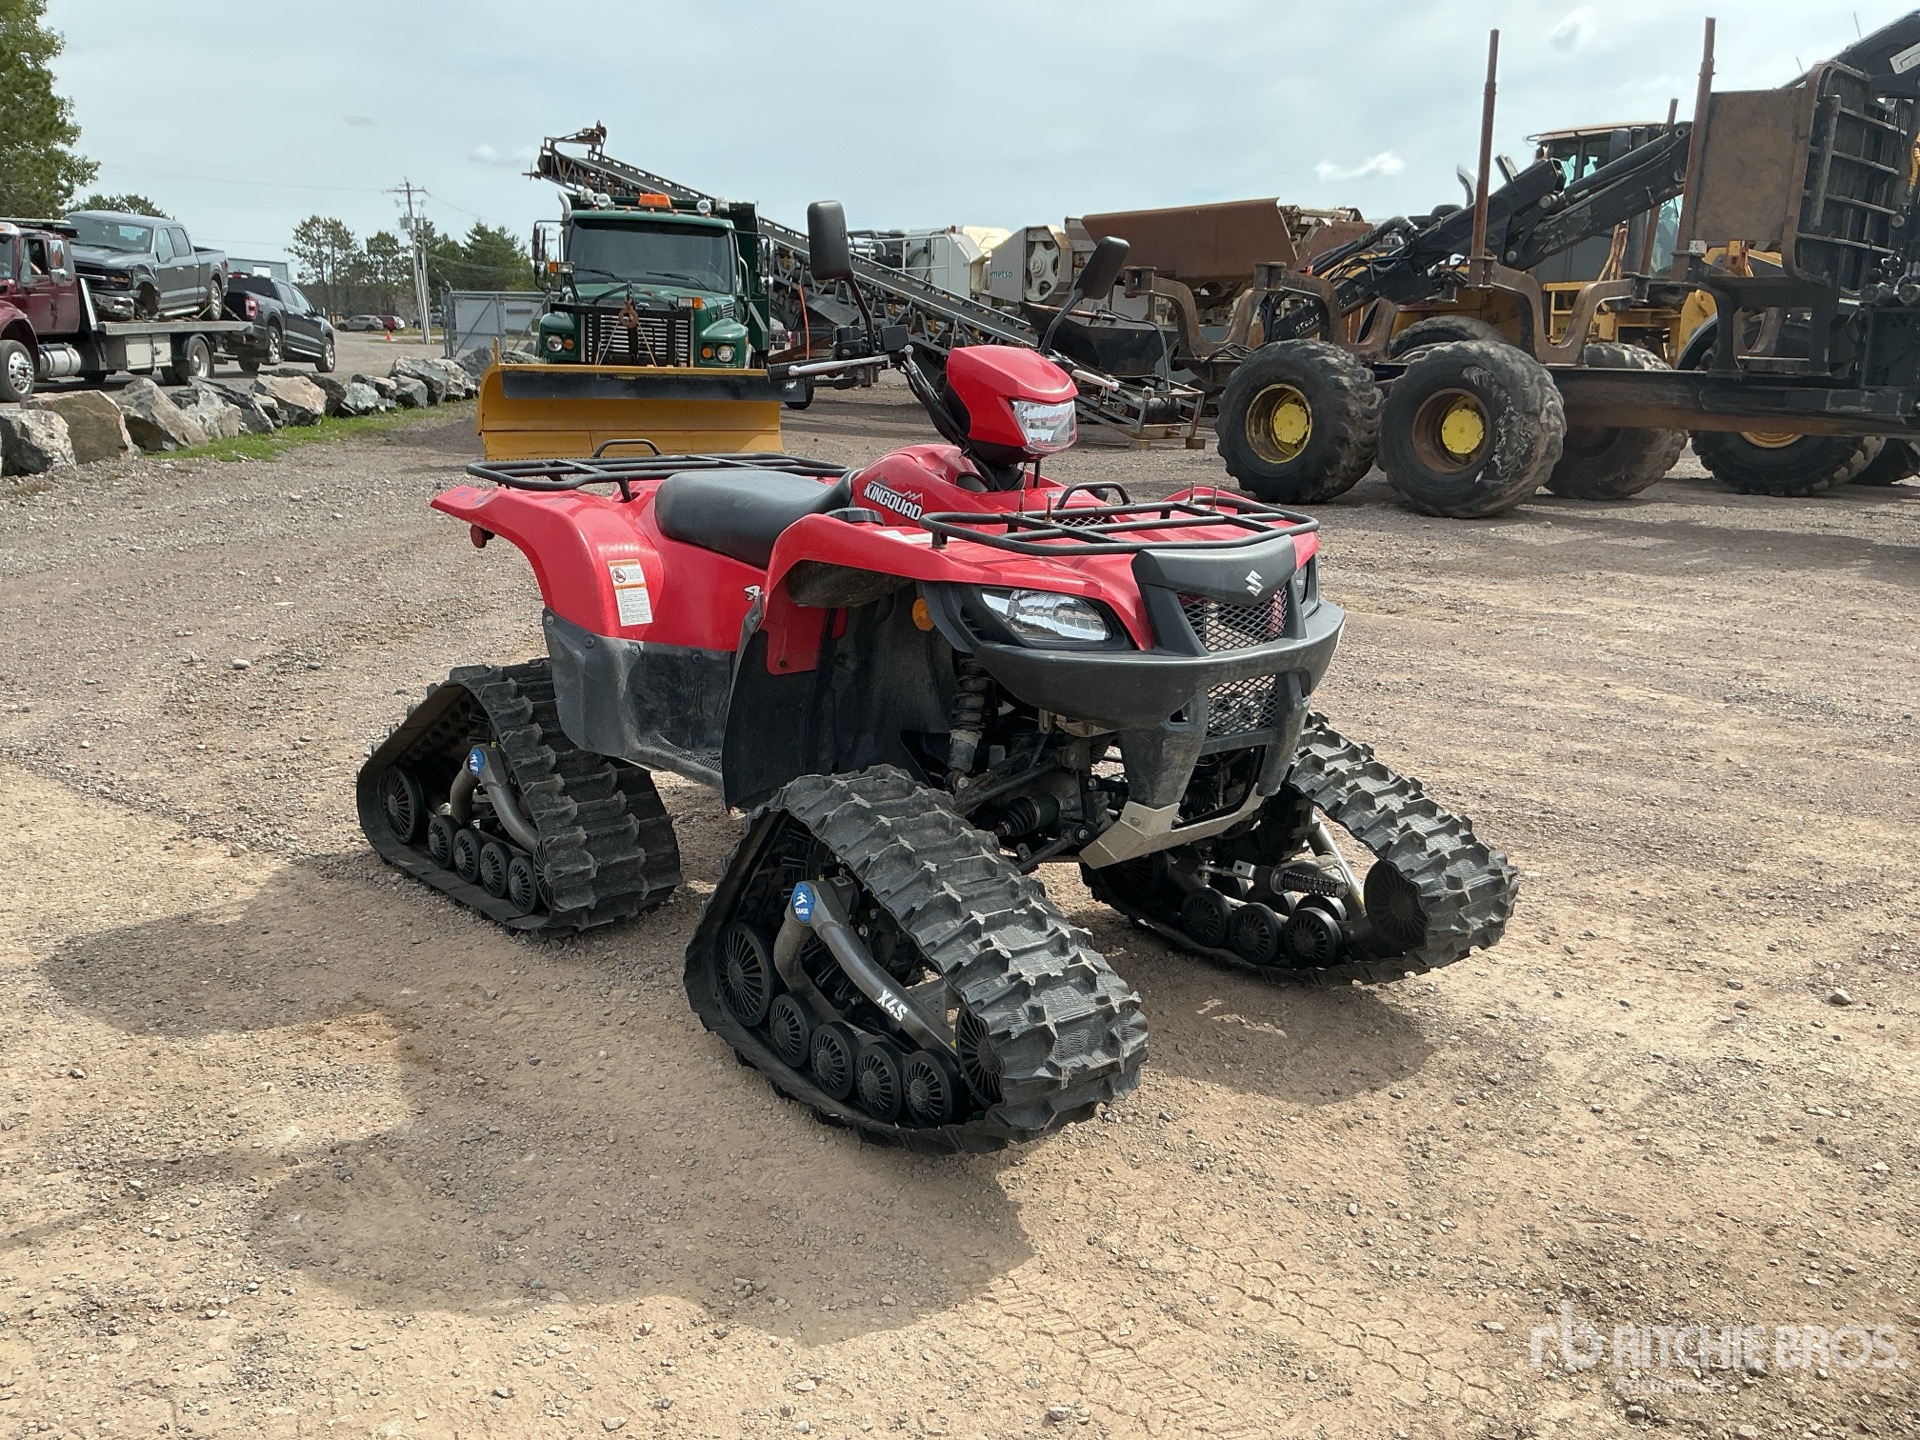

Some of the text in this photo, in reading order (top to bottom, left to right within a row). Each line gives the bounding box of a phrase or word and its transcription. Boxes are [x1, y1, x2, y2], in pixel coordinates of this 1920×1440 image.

[991, 270, 1013, 279] metso
[863, 483, 923, 521] KINGQUAD
[876, 989, 909, 1022] X4S
